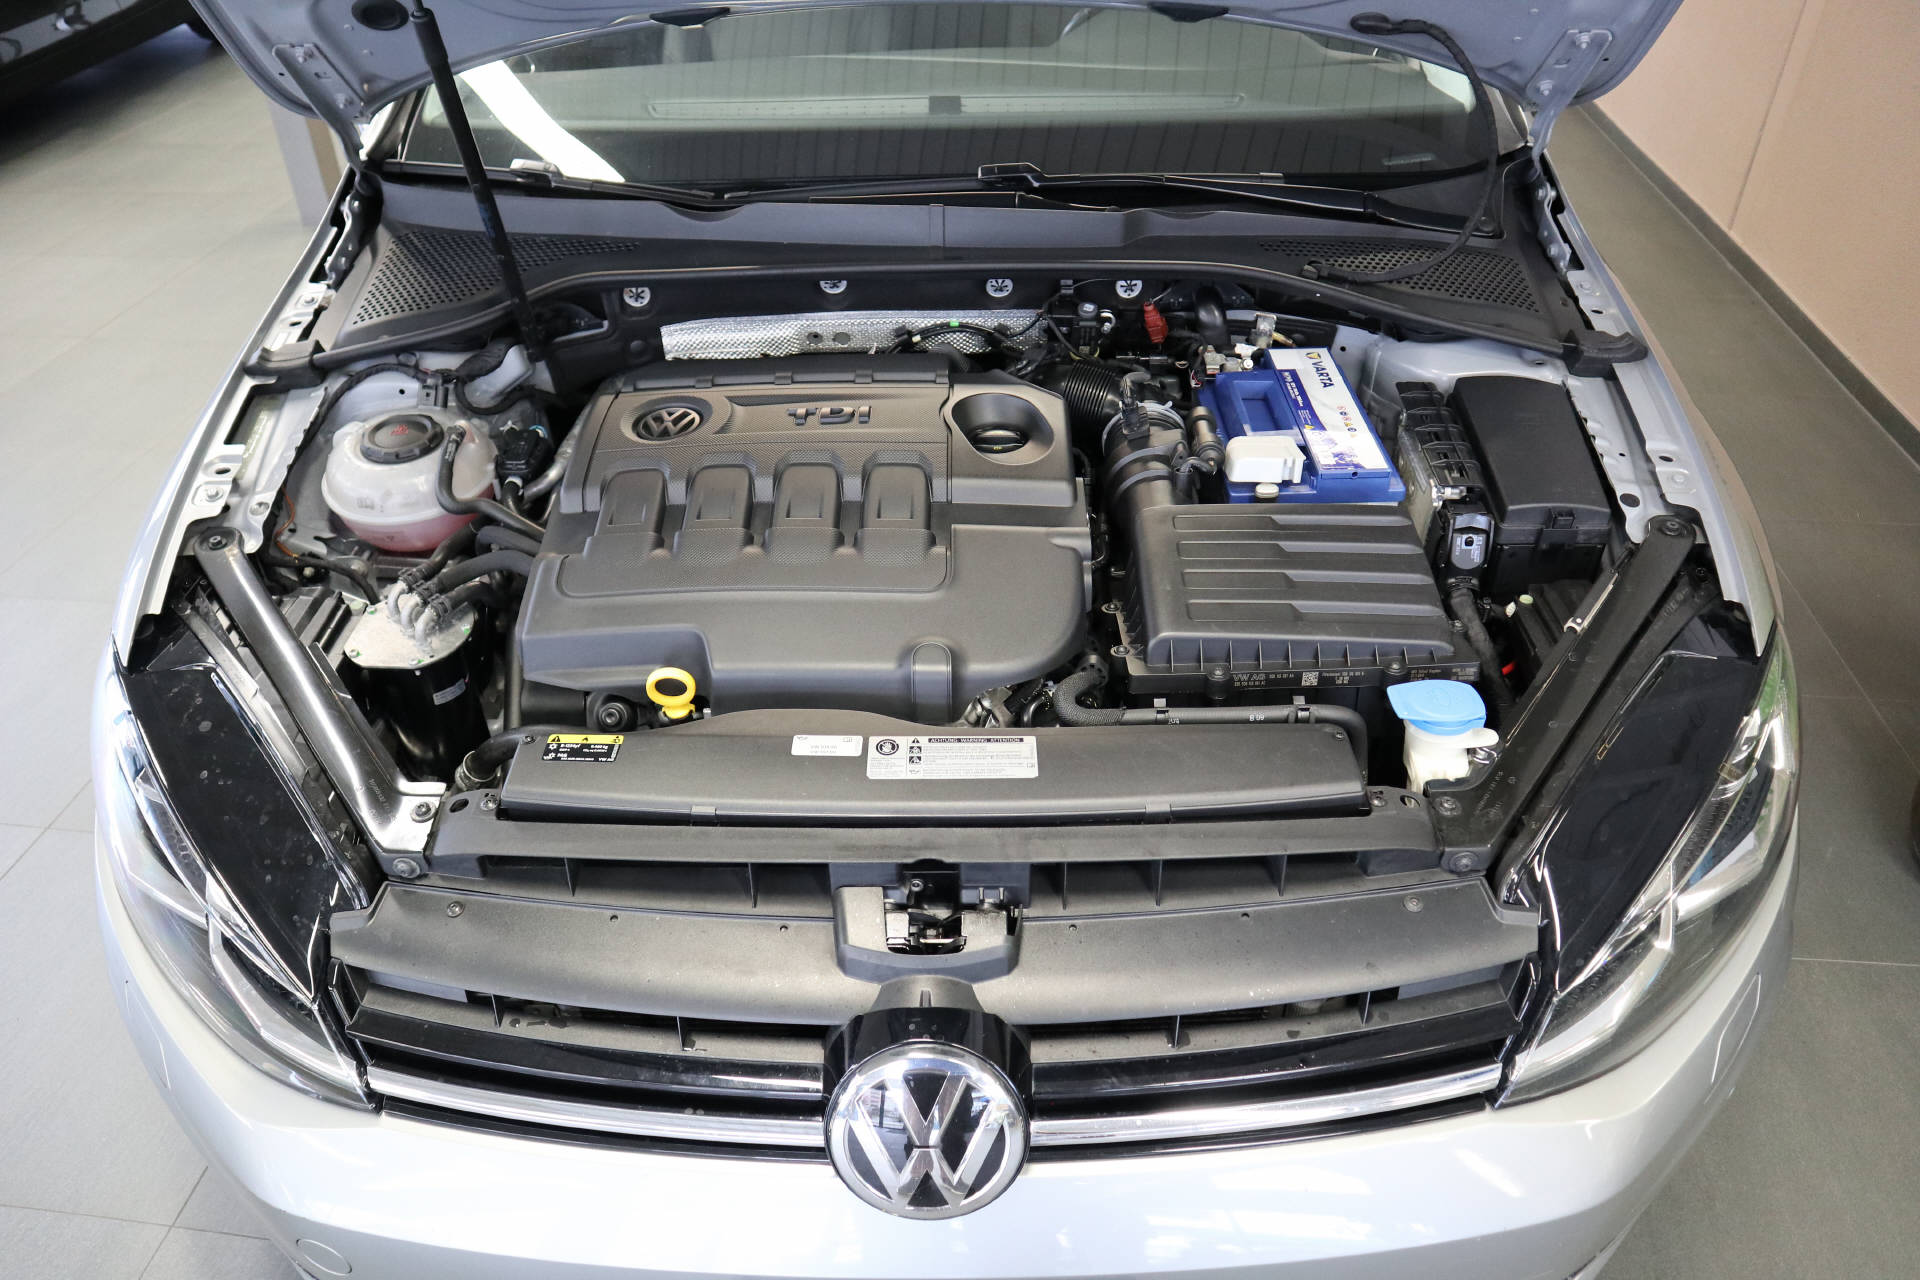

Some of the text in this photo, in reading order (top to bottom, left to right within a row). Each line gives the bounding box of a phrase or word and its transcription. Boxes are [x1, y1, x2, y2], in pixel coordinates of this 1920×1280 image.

[1311, 360, 1335, 389] VARTA
[637, 407, 702, 440] VW
[786, 404, 873, 426] TDI
[1232, 673, 1250, 681] VW
[835, 1053, 1022, 1213] VW
